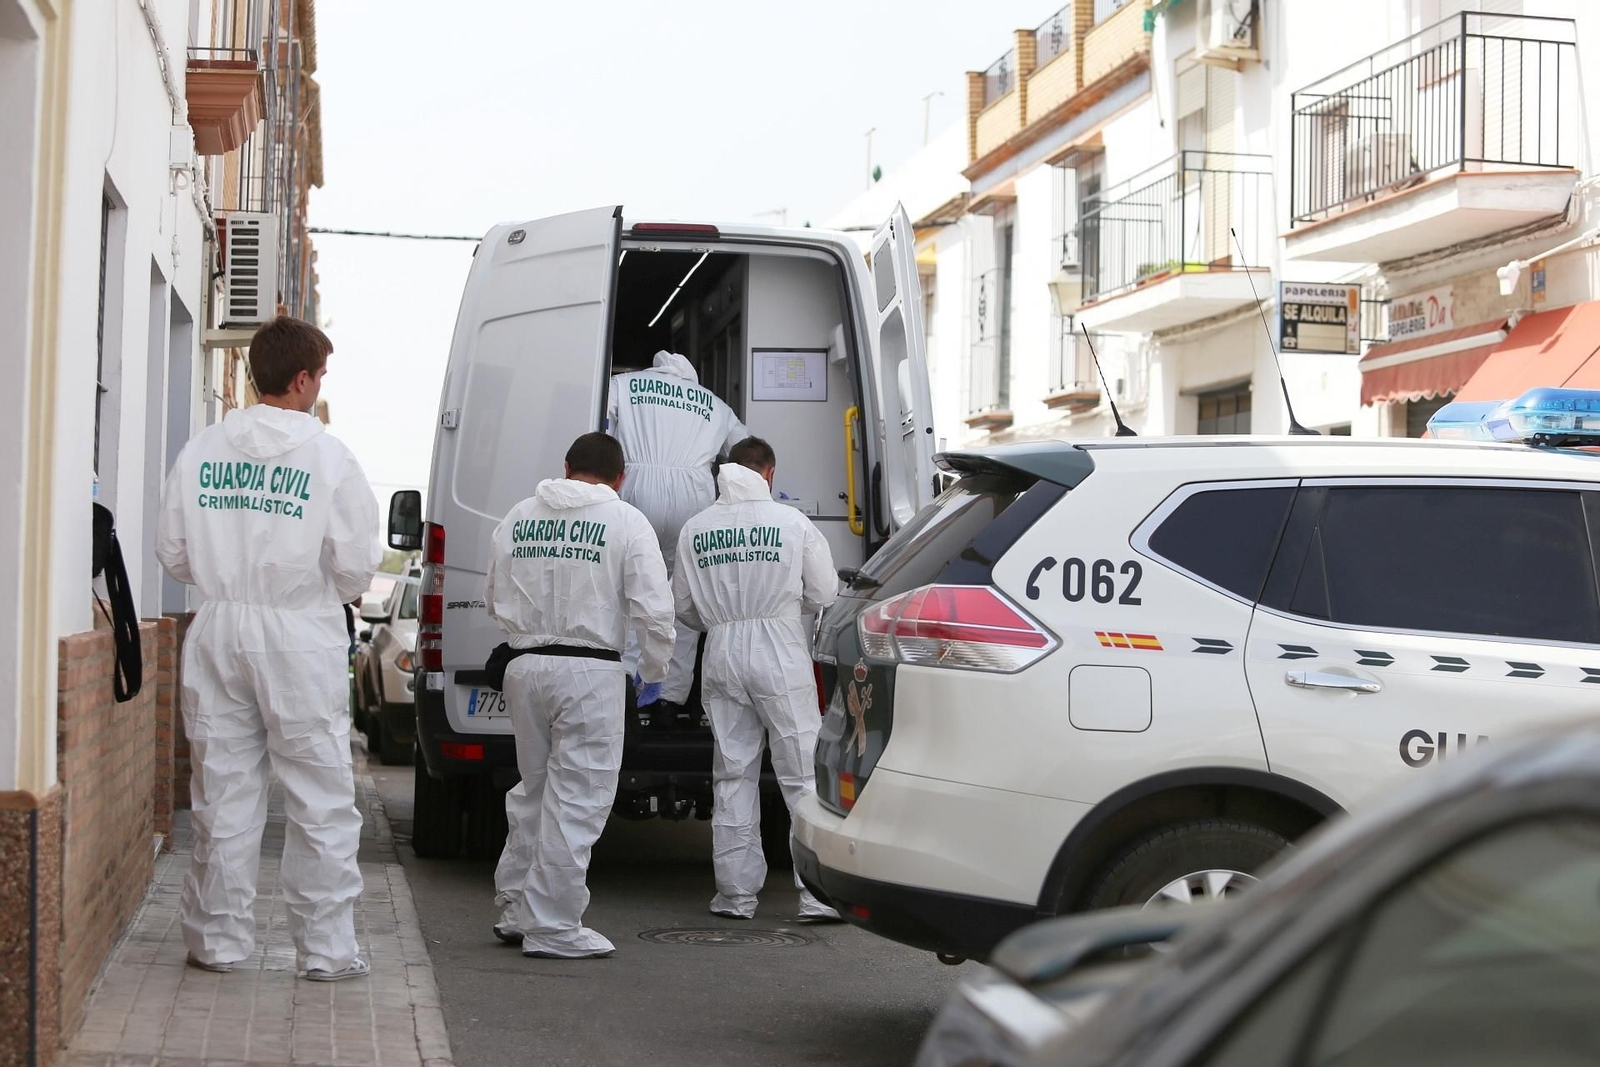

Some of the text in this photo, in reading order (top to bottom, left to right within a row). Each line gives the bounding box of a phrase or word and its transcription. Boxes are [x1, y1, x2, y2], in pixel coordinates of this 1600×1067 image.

[1284, 304, 1346, 323] SE ALQUILA
[629, 378, 714, 412] GUARDIA CIVIL
[630, 396, 711, 422] CRIMINALÍSTICA
[200, 461, 311, 500] GUARDIA CIVIL
[512, 519, 606, 547] GUARDIA CIVIL
[693, 526, 782, 554] GUARDIA CIVIL
[698, 549, 780, 569] CRIMINALÍSTICA
[1062, 557, 1143, 606] 062
[446, 600, 486, 609] SPRINTE
